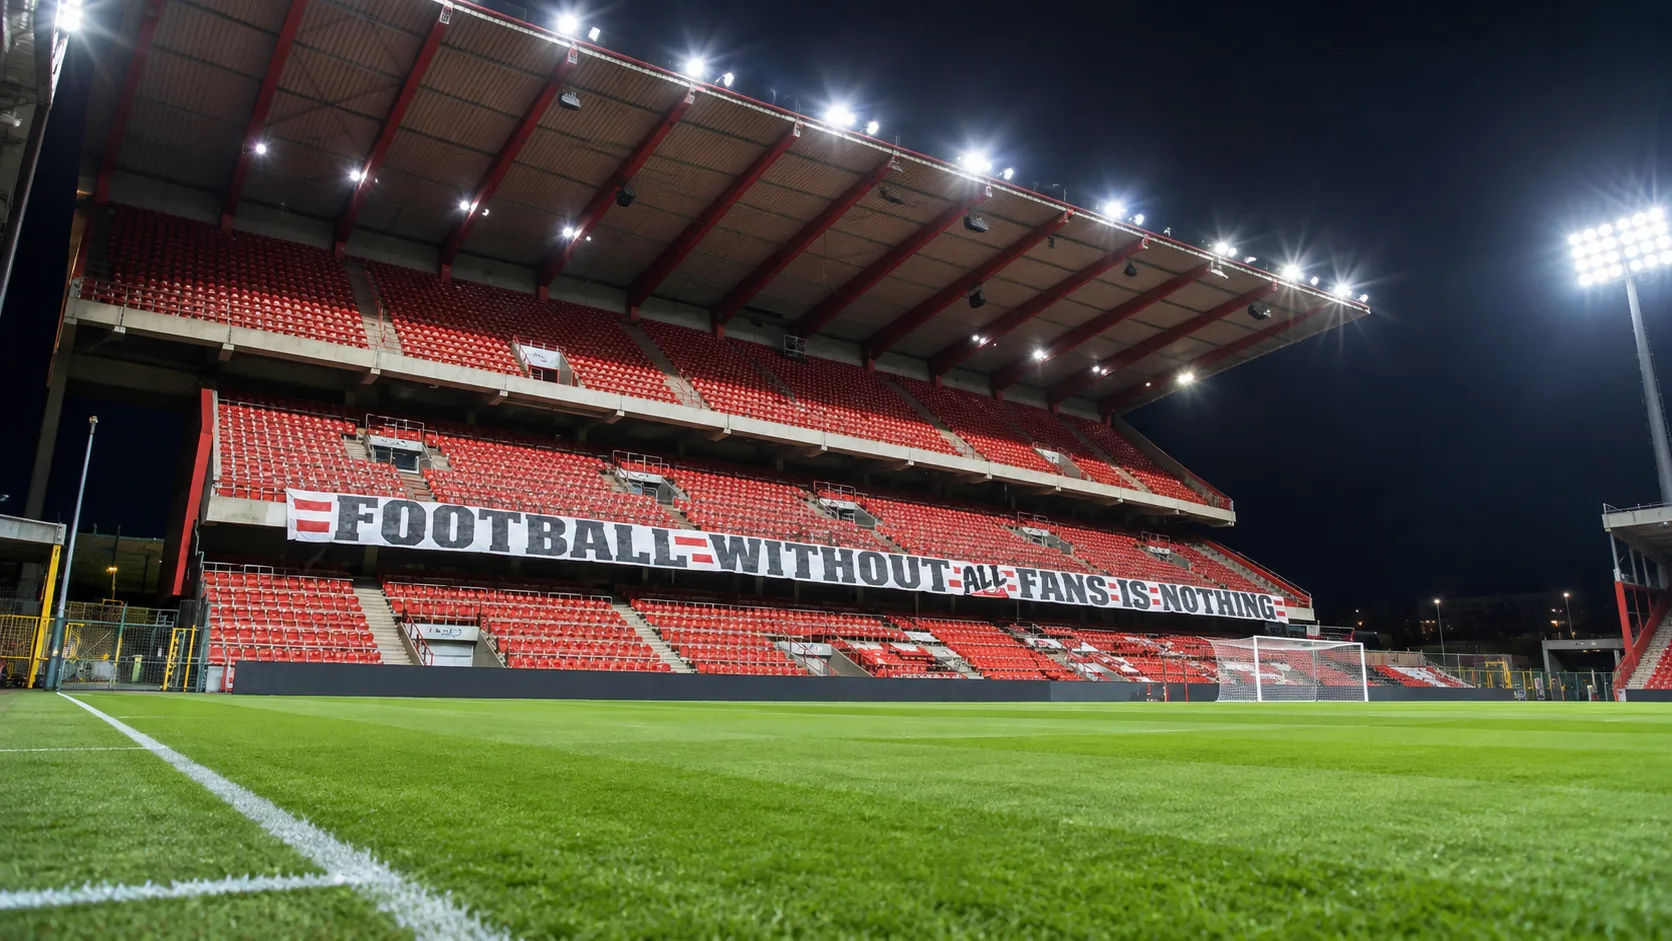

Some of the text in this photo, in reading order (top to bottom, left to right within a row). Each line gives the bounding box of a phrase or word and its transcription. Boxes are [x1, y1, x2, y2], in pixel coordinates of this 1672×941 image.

[334, 494, 1275, 619] FOOTBALL WITHOUT ALL FANS IS NOTHING
